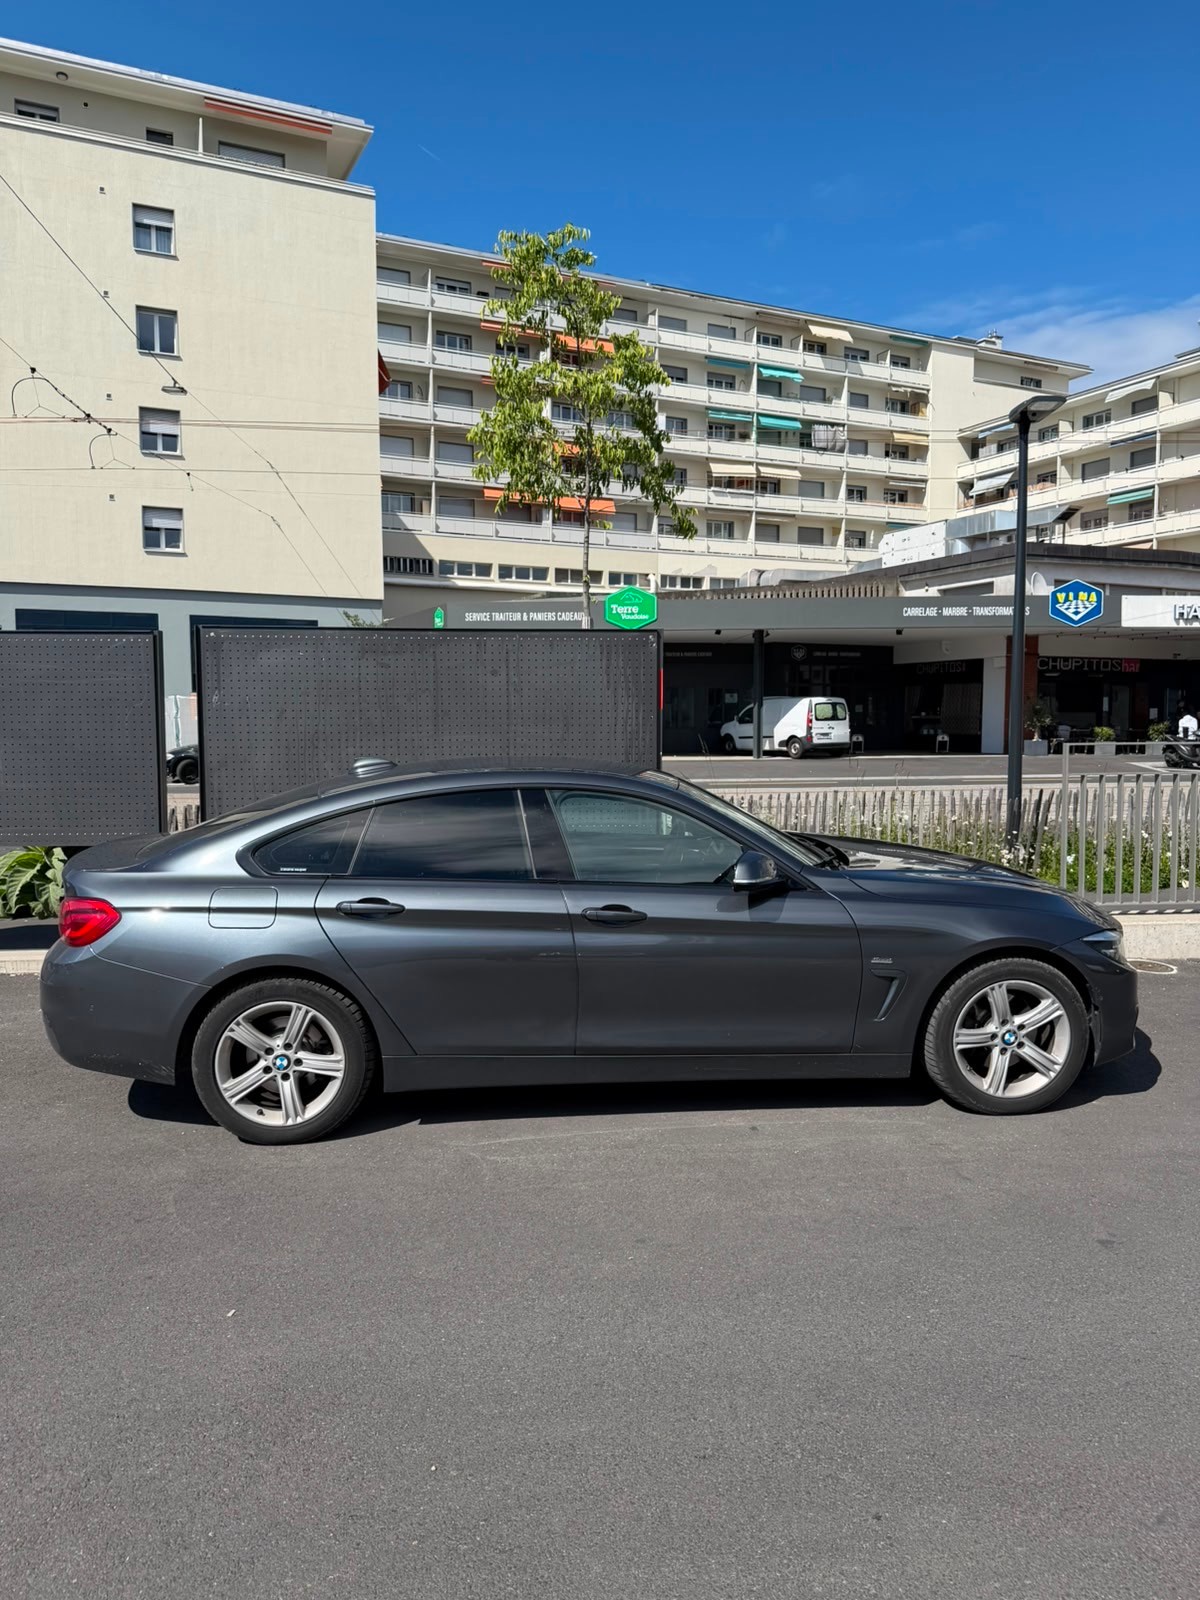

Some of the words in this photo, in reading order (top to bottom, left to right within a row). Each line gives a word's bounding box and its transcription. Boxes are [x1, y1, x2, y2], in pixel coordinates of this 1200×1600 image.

[611, 604, 639, 614] Terre
[903, 607, 938, 616] CARRELAGE
[942, 607, 968, 616] MARBRE
[972, 606, 1030, 616] TRANSFORMAS
[465, 612, 491, 621] SERVICE
[492, 612, 521, 621] TRAITEUR
[523, 612, 528, 621] &
[529, 612, 556, 621] PANIERS
[1037, 657, 1121, 671] CHUPITOS
